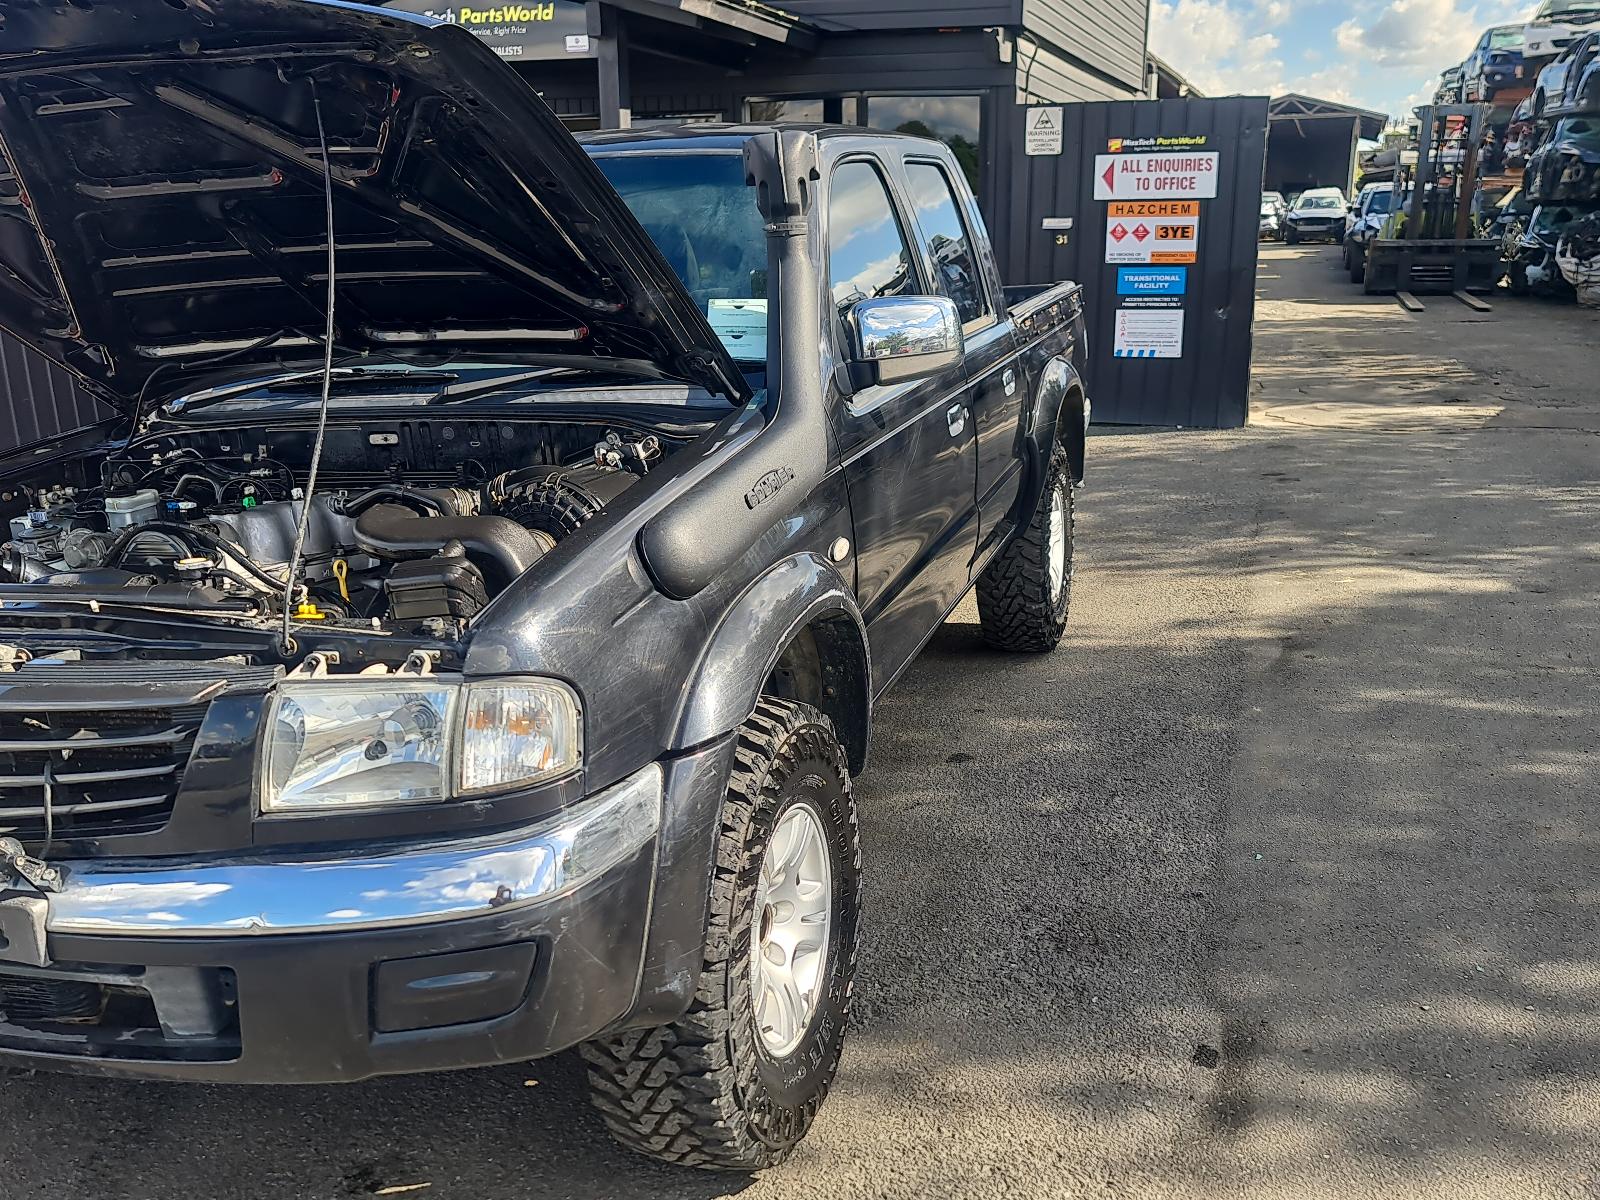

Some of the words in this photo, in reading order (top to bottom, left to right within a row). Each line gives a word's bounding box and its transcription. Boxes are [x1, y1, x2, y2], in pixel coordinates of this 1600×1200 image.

[460, 2, 554, 24] PartsWorld
[493, 25, 510, 37] Right
[511, 25, 527, 34] Price
[1156, 135, 1207, 146] PartsWorld
[1120, 159, 1143, 174] ALL
[1146, 158, 1213, 174] ENQUIRIES
[1136, 177, 1150, 191] TO
[1154, 176, 1196, 191] OFFICE
[1115, 204, 1191, 215] HAZCHEM
[1159, 226, 1190, 239] 3YE
[1055, 234, 1068, 245] 31
